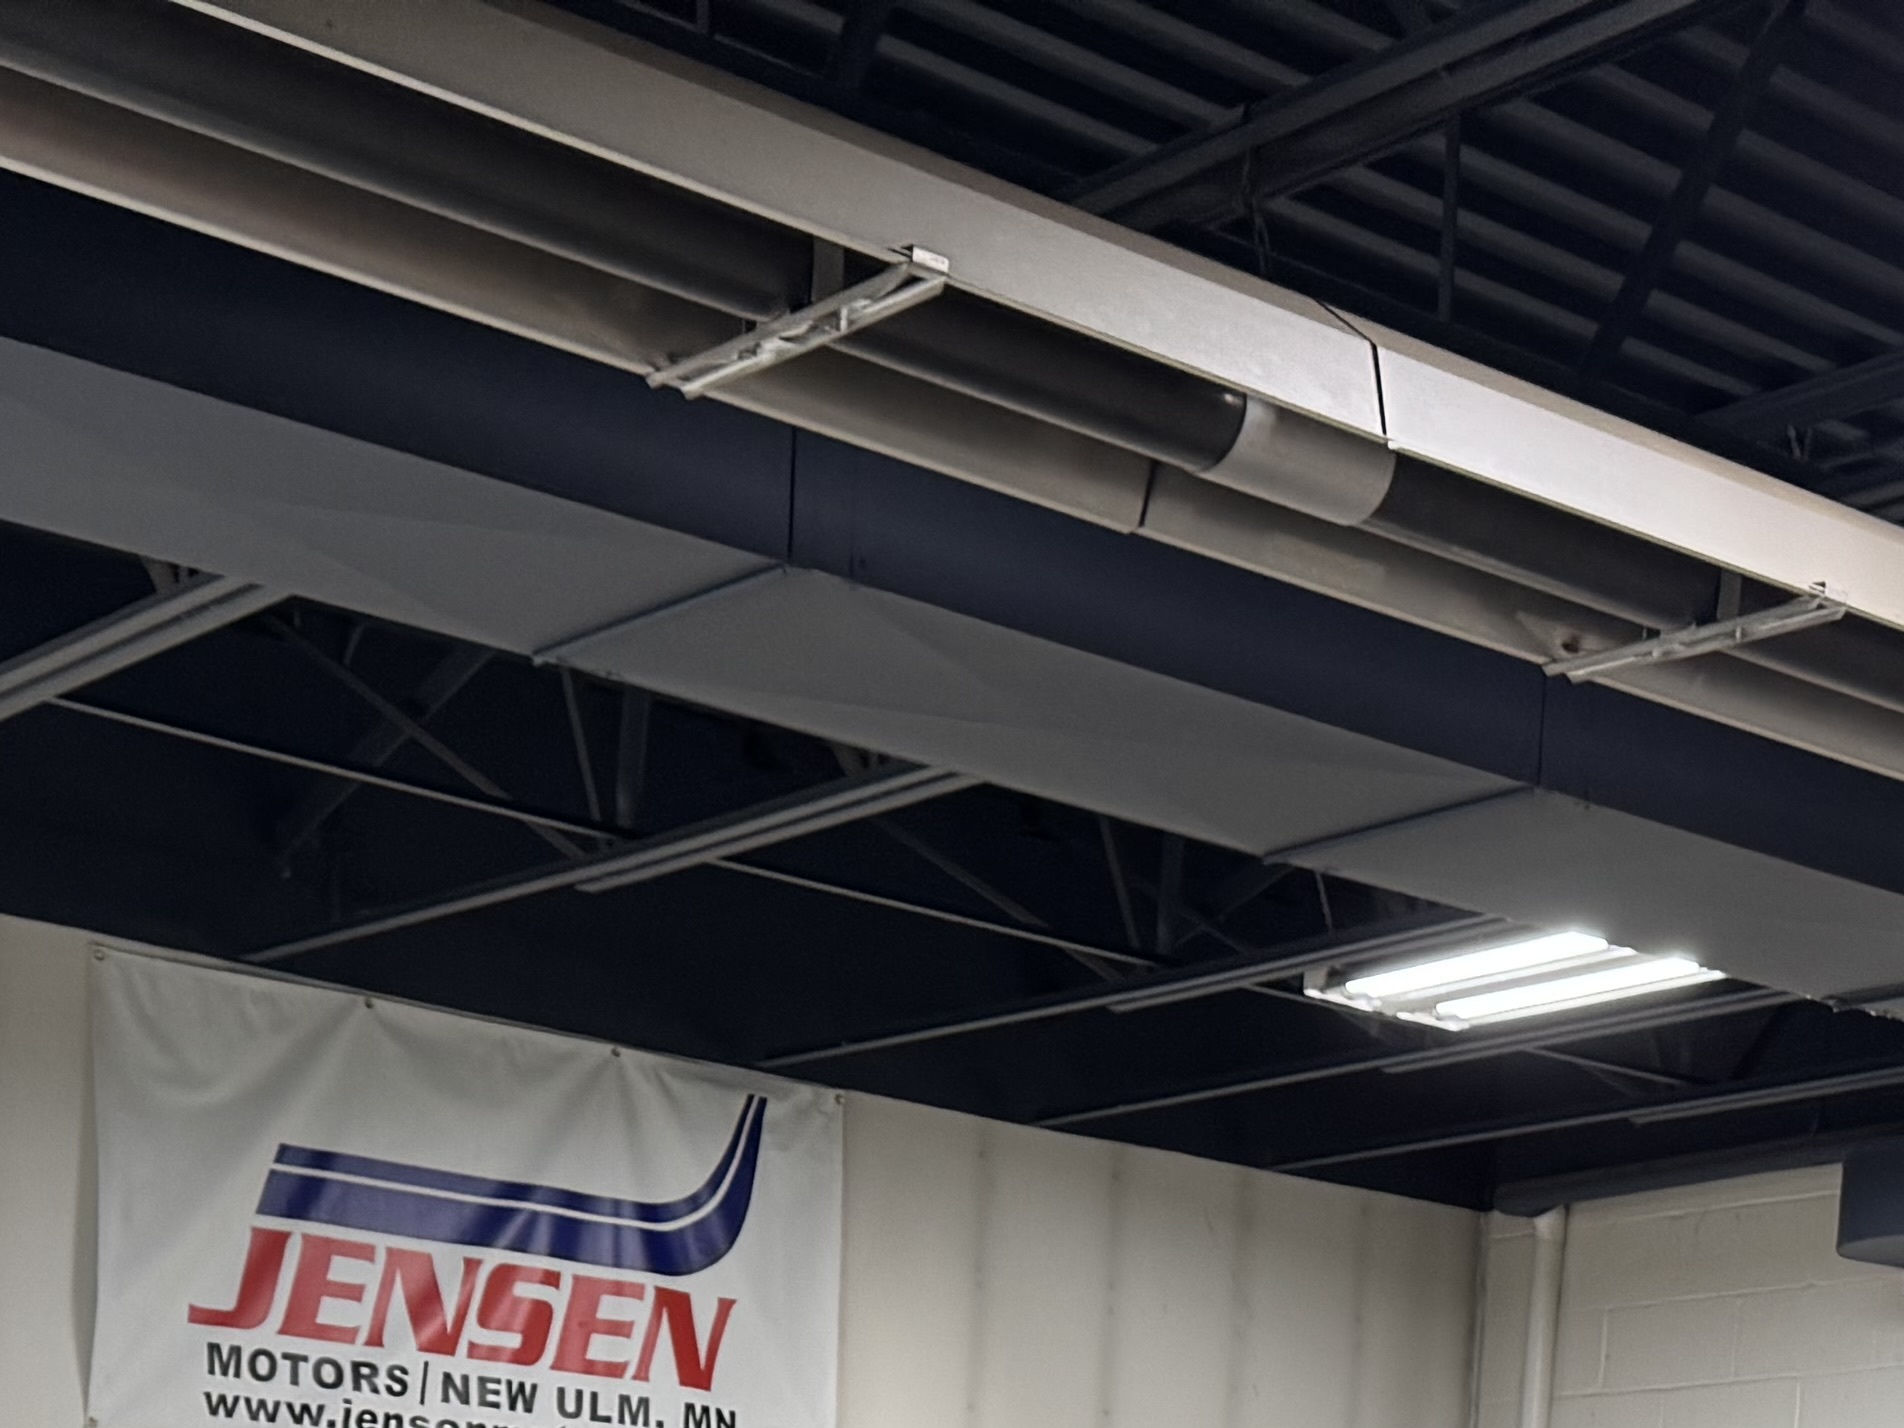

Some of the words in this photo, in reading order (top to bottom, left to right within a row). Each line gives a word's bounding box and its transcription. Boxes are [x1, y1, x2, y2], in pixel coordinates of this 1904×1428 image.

[187, 1226, 738, 1392] JENSEN
[206, 1341, 410, 1398] MOTORS
[440, 1370, 538, 1414] NEW
